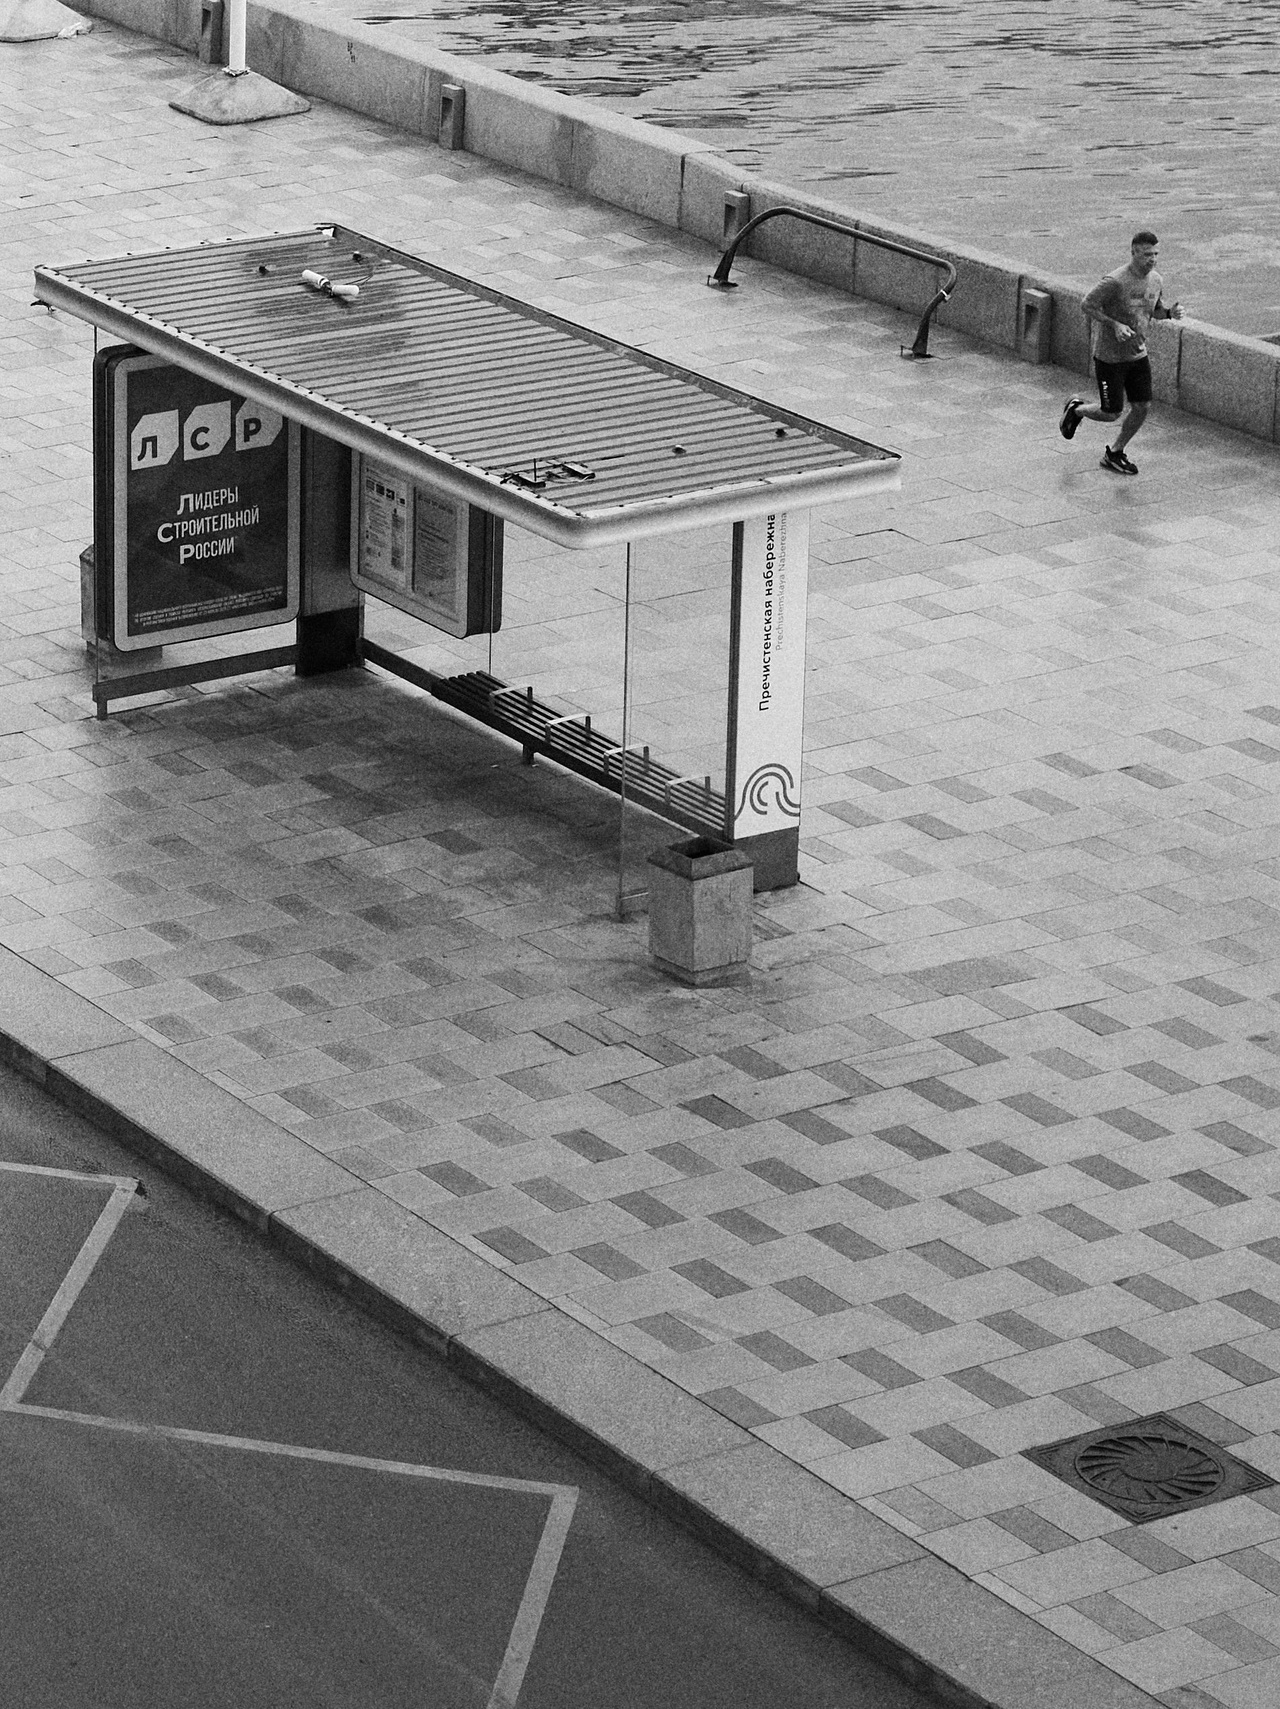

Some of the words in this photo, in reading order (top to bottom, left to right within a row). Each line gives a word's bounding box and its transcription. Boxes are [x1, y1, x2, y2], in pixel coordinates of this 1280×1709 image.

[177, 486, 238, 515] ЛИДЕРЫ
[157, 504, 259, 543] СТРОИТЕЛЬНОЙ
[179, 537, 234, 565] РОССИИ
[775, 574, 786, 651] Prechistenskaya
[759, 600, 773, 712] Пречистенская
